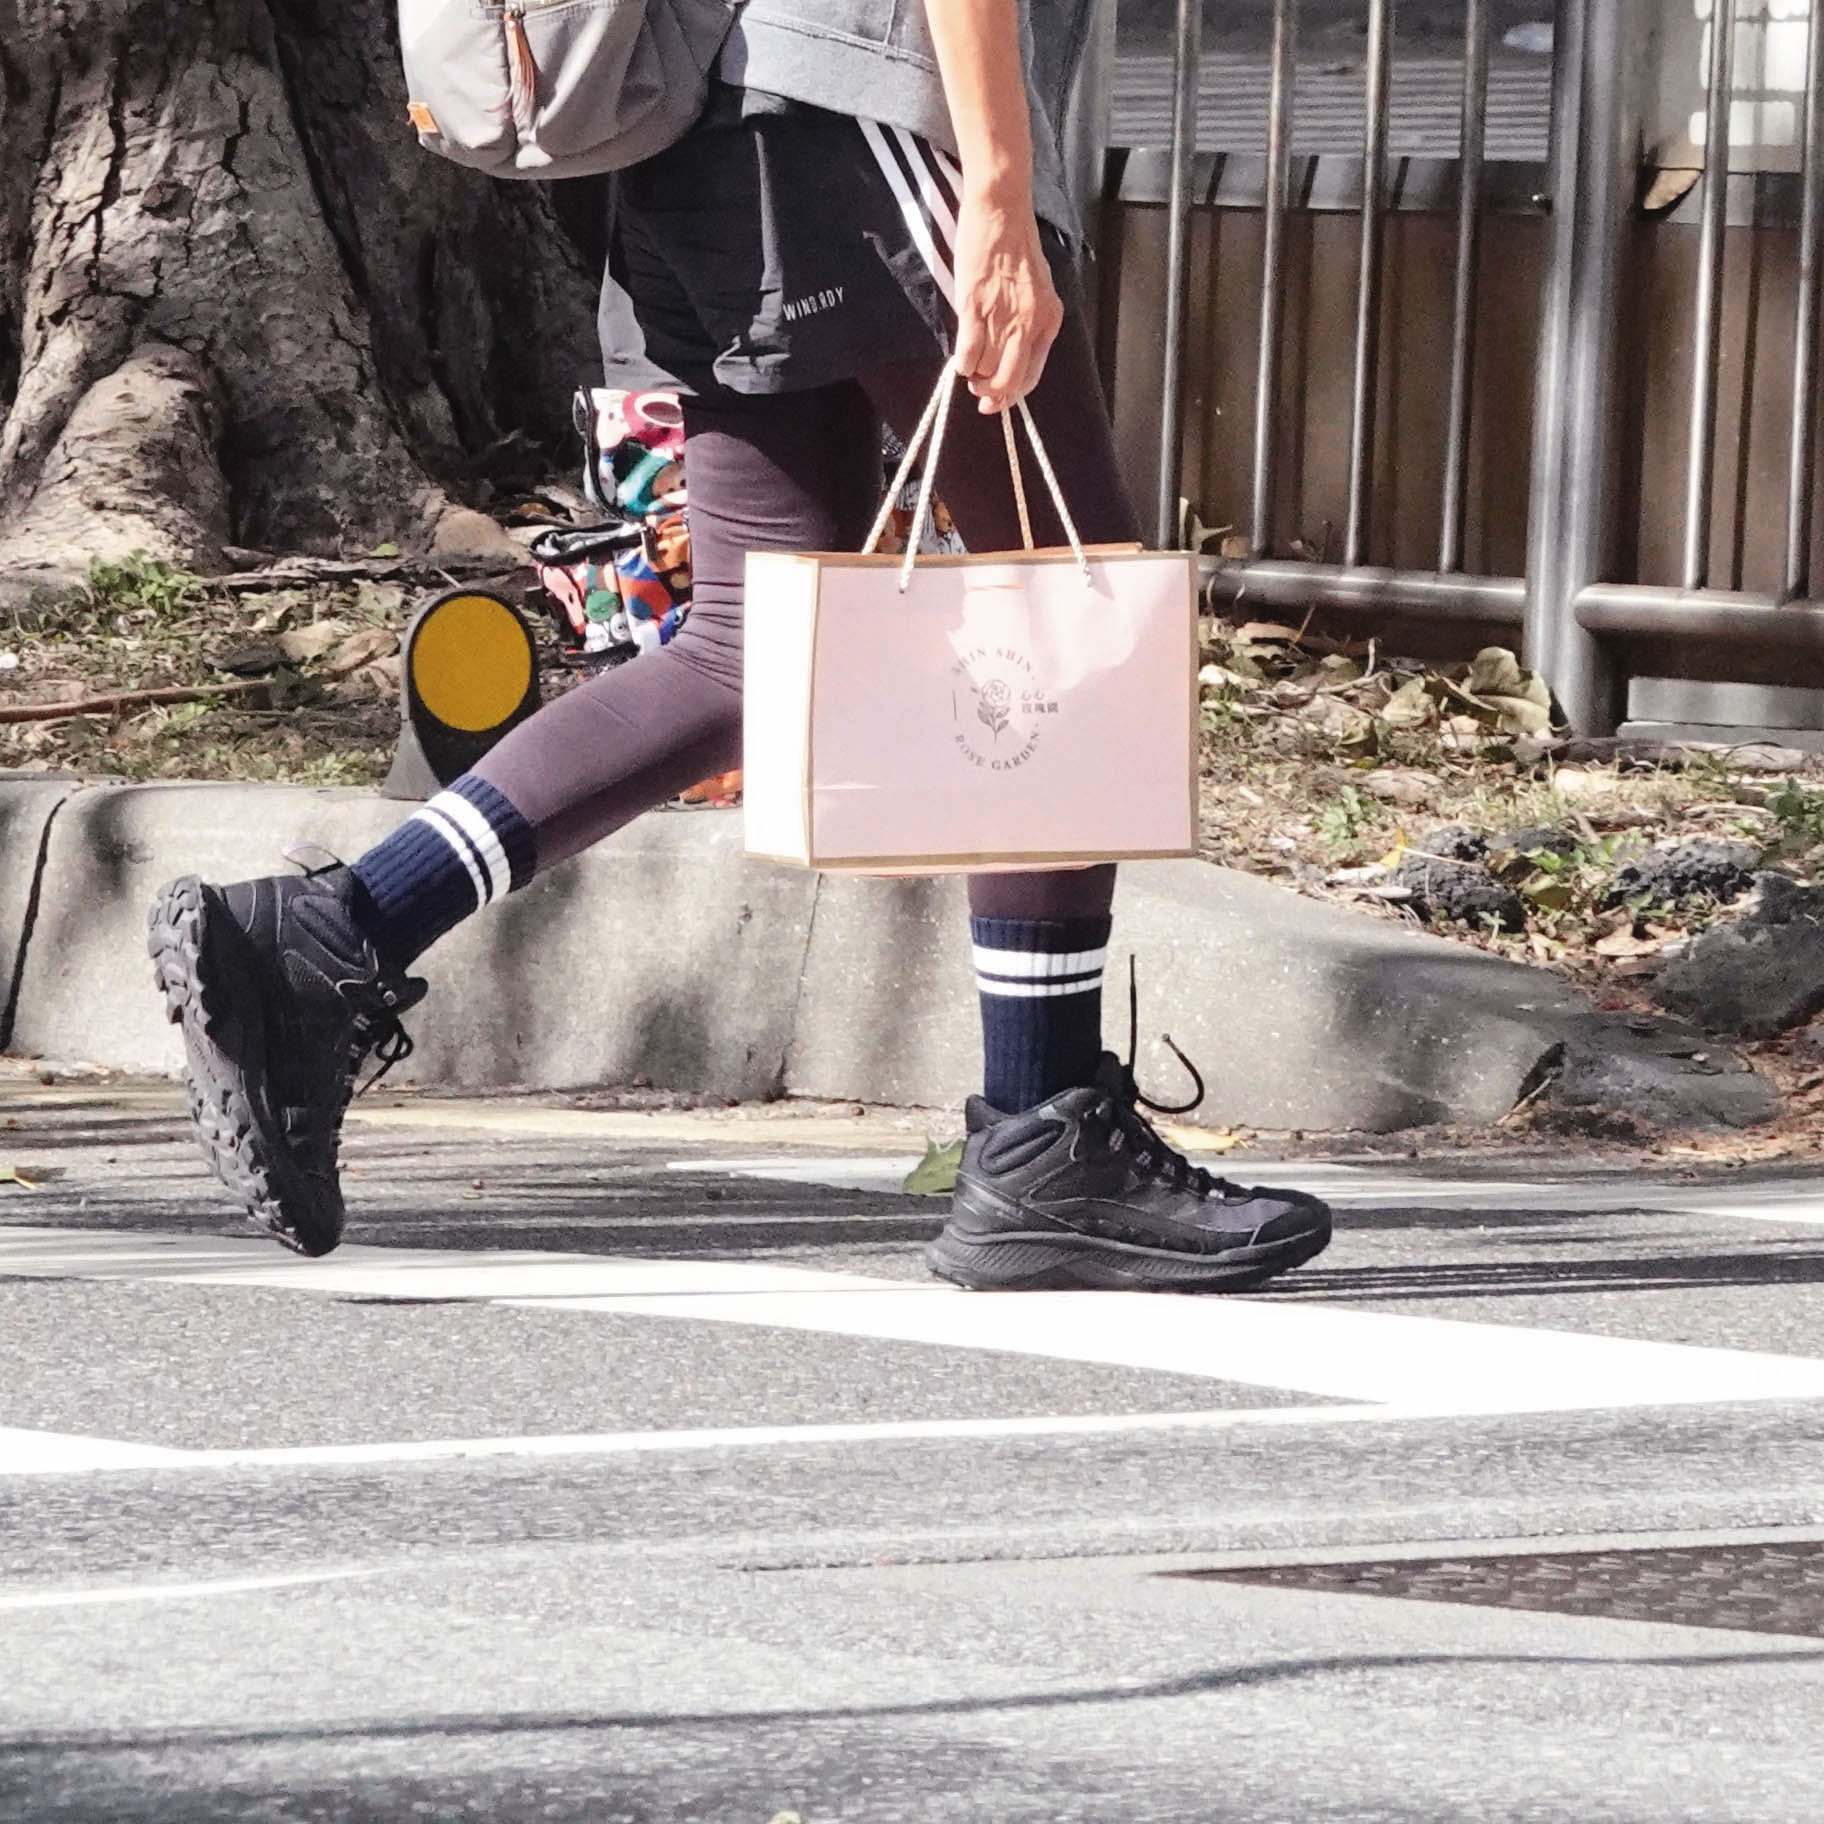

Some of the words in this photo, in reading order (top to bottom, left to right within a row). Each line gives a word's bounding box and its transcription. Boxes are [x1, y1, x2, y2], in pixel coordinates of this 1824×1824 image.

[782, 286, 844, 321] WIND.RDY
[954, 733, 986, 767] ROSE
[991, 729, 1040, 771] GARDEN
